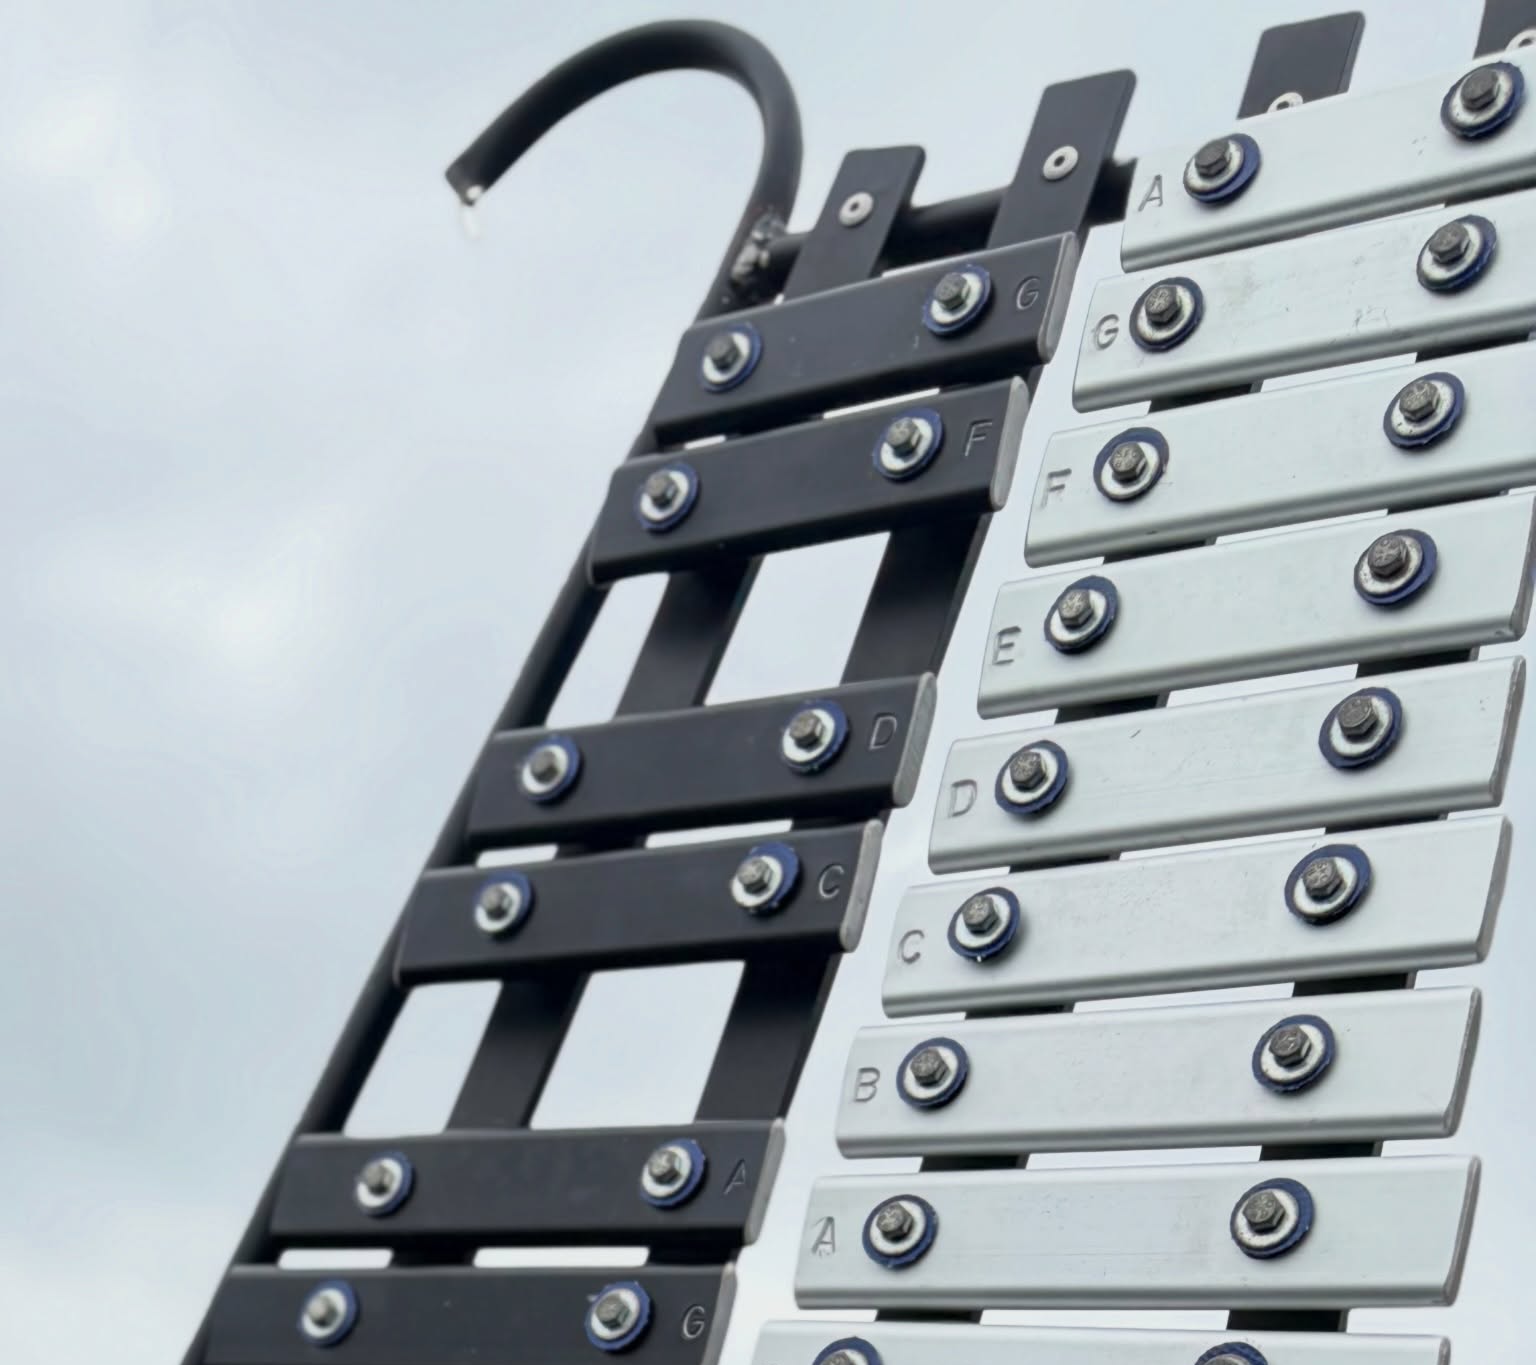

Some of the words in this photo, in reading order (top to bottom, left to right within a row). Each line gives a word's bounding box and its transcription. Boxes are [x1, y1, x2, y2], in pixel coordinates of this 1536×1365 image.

[1138, 175, 1164, 211] A
[1017, 277, 1040, 310] G
[1095, 314, 1119, 350] G
[964, 419, 993, 457] F
[1040, 468, 1072, 508] F
[992, 626, 1021, 665] E
[870, 713, 897, 749] D
[949, 779, 977, 817] D
[818, 865, 844, 898] C
[899, 930, 925, 963] C
[853, 1068, 881, 1102] B
[724, 1159, 747, 1194] A
[811, 1216, 837, 1256] A
[682, 1305, 705, 1340] G
